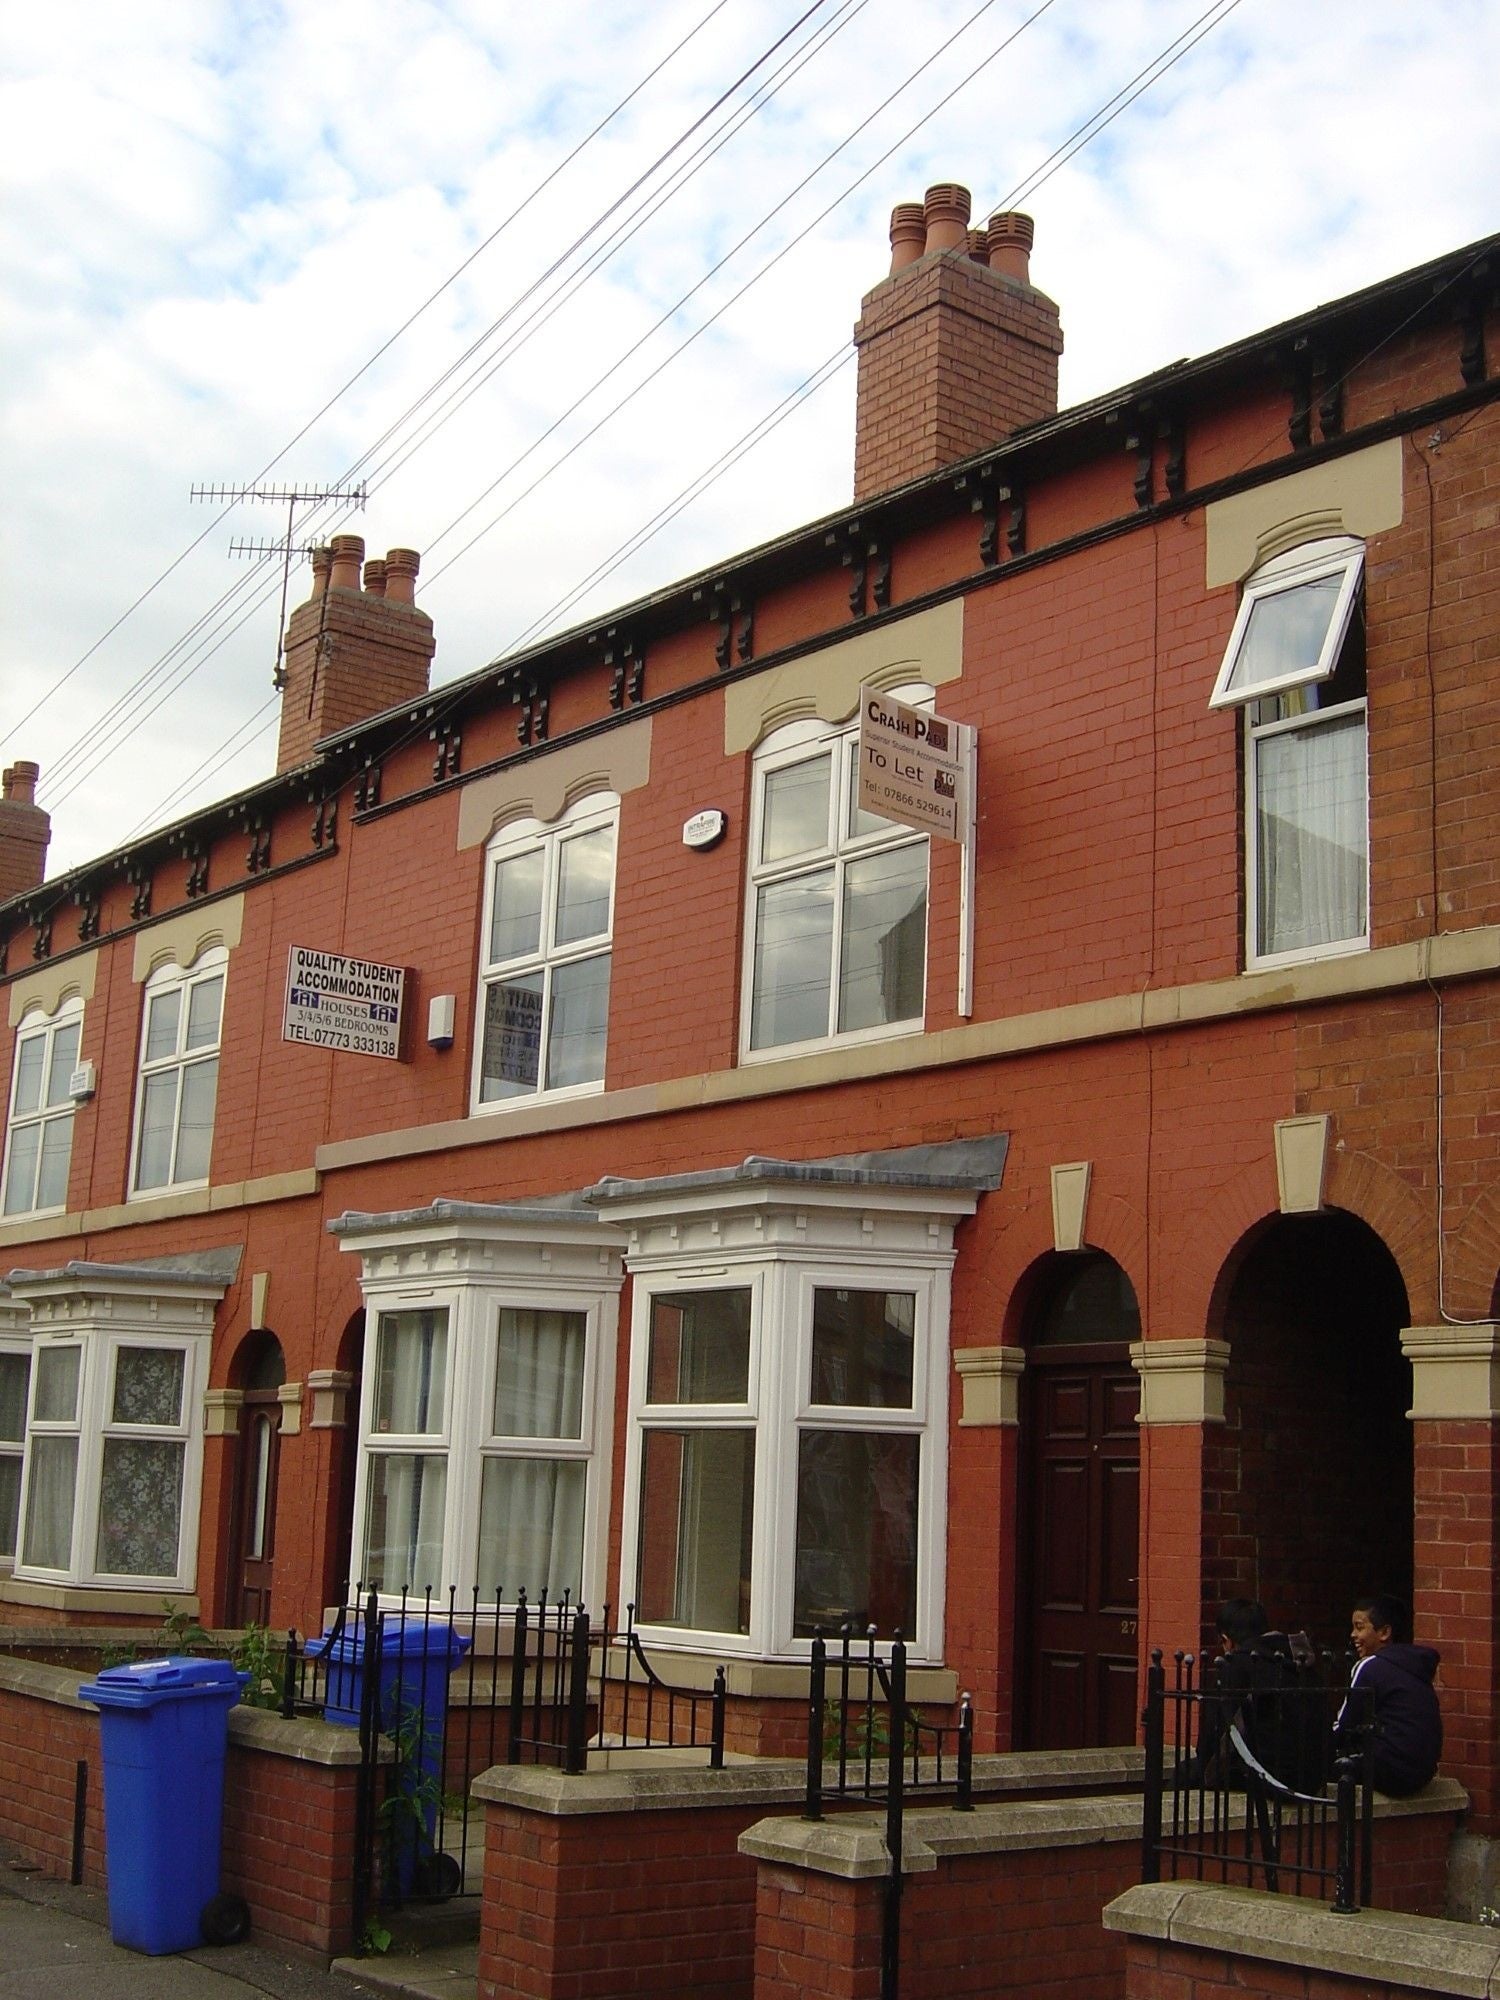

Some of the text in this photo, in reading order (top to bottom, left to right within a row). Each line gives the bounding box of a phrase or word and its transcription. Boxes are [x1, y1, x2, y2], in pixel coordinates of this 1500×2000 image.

[867, 701, 947, 748] CRASH PADS
[892, 740, 915, 756] Student
[865, 746, 886, 768] To
[895, 758, 924, 783] Let
[941, 773, 954, 786] 10
[864, 779, 880, 794] Tel:
[884, 787, 914, 806] 07866
[916, 798, 952, 819] 529614
[297, 950, 401, 985] QUALITY STUDENT
[296, 970, 399, 1004] ACCOMMODATION
[320, 1000, 368, 1019] HOUSES
[297, 1010, 389, 1036] 3/4/5/6 BEDROOMS
[353, 1035, 395, 1056] 333138
[1121, 1620, 1137, 1635] 27
